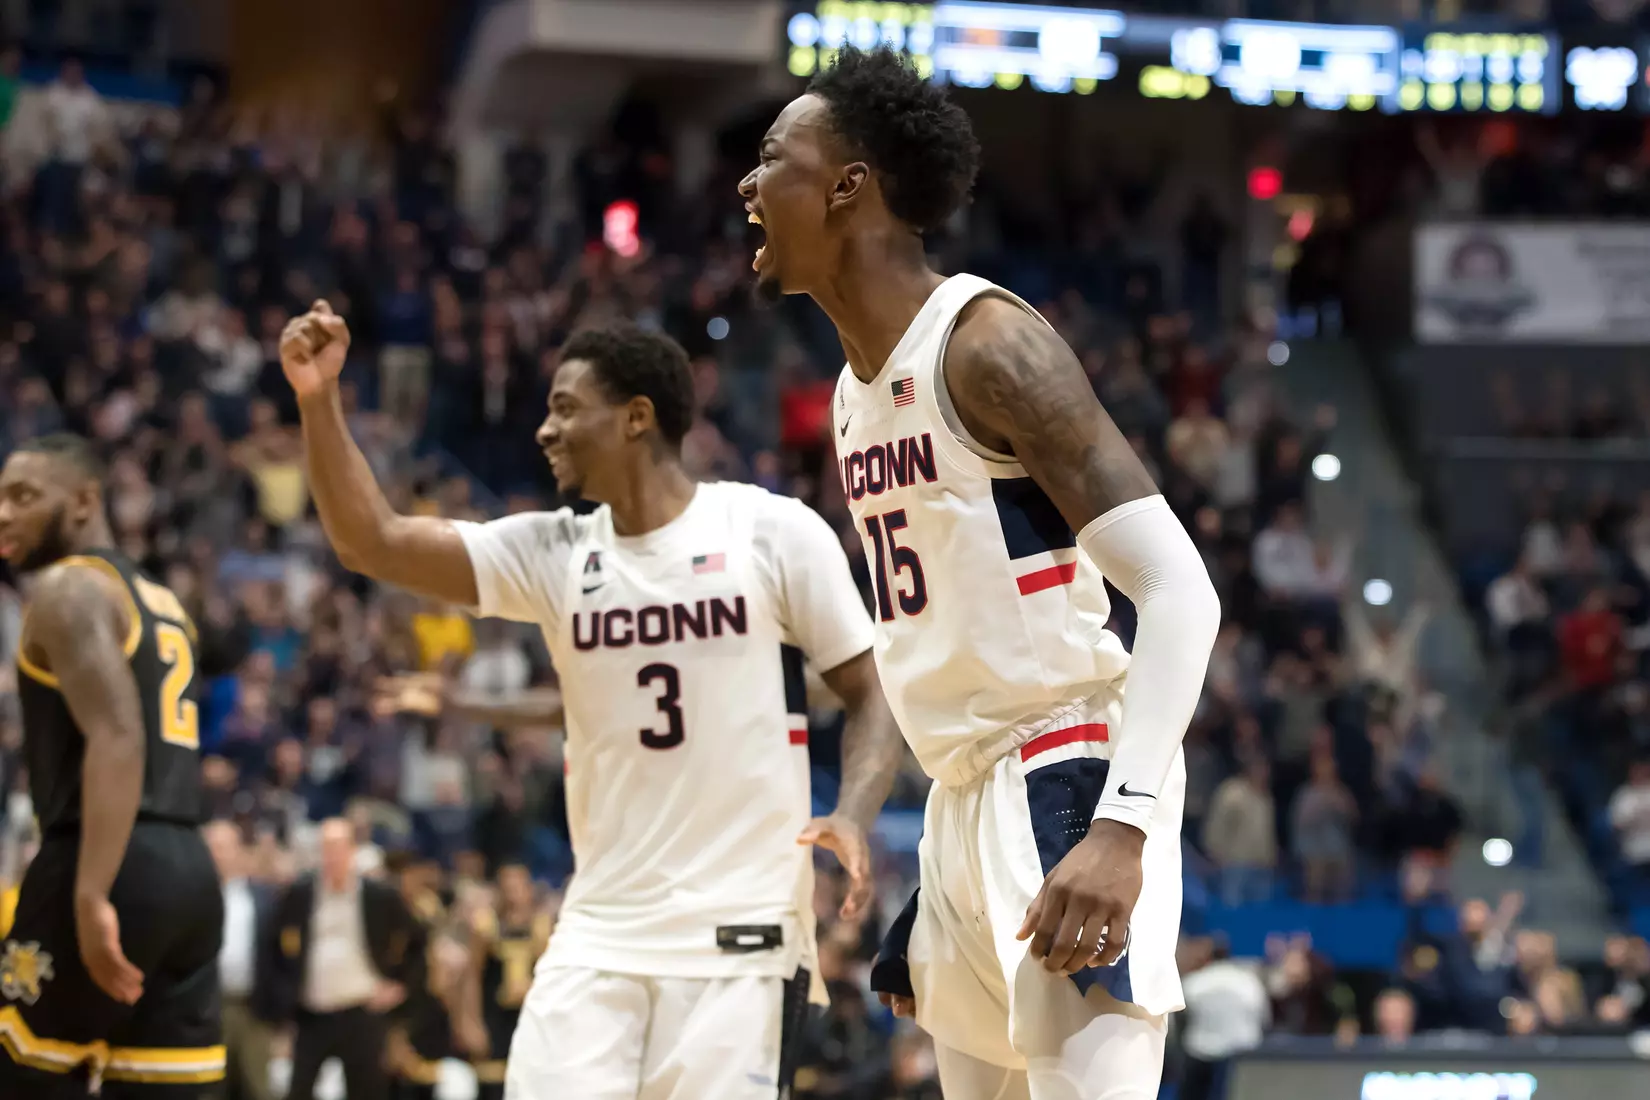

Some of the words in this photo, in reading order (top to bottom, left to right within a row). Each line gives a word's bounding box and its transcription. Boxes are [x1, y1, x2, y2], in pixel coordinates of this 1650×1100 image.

[840, 433, 938, 505] UCONN
[864, 508, 928, 622] 15
[573, 596, 748, 651] UCONN
[156, 622, 200, 750] 2
[636, 662, 685, 751] 3
